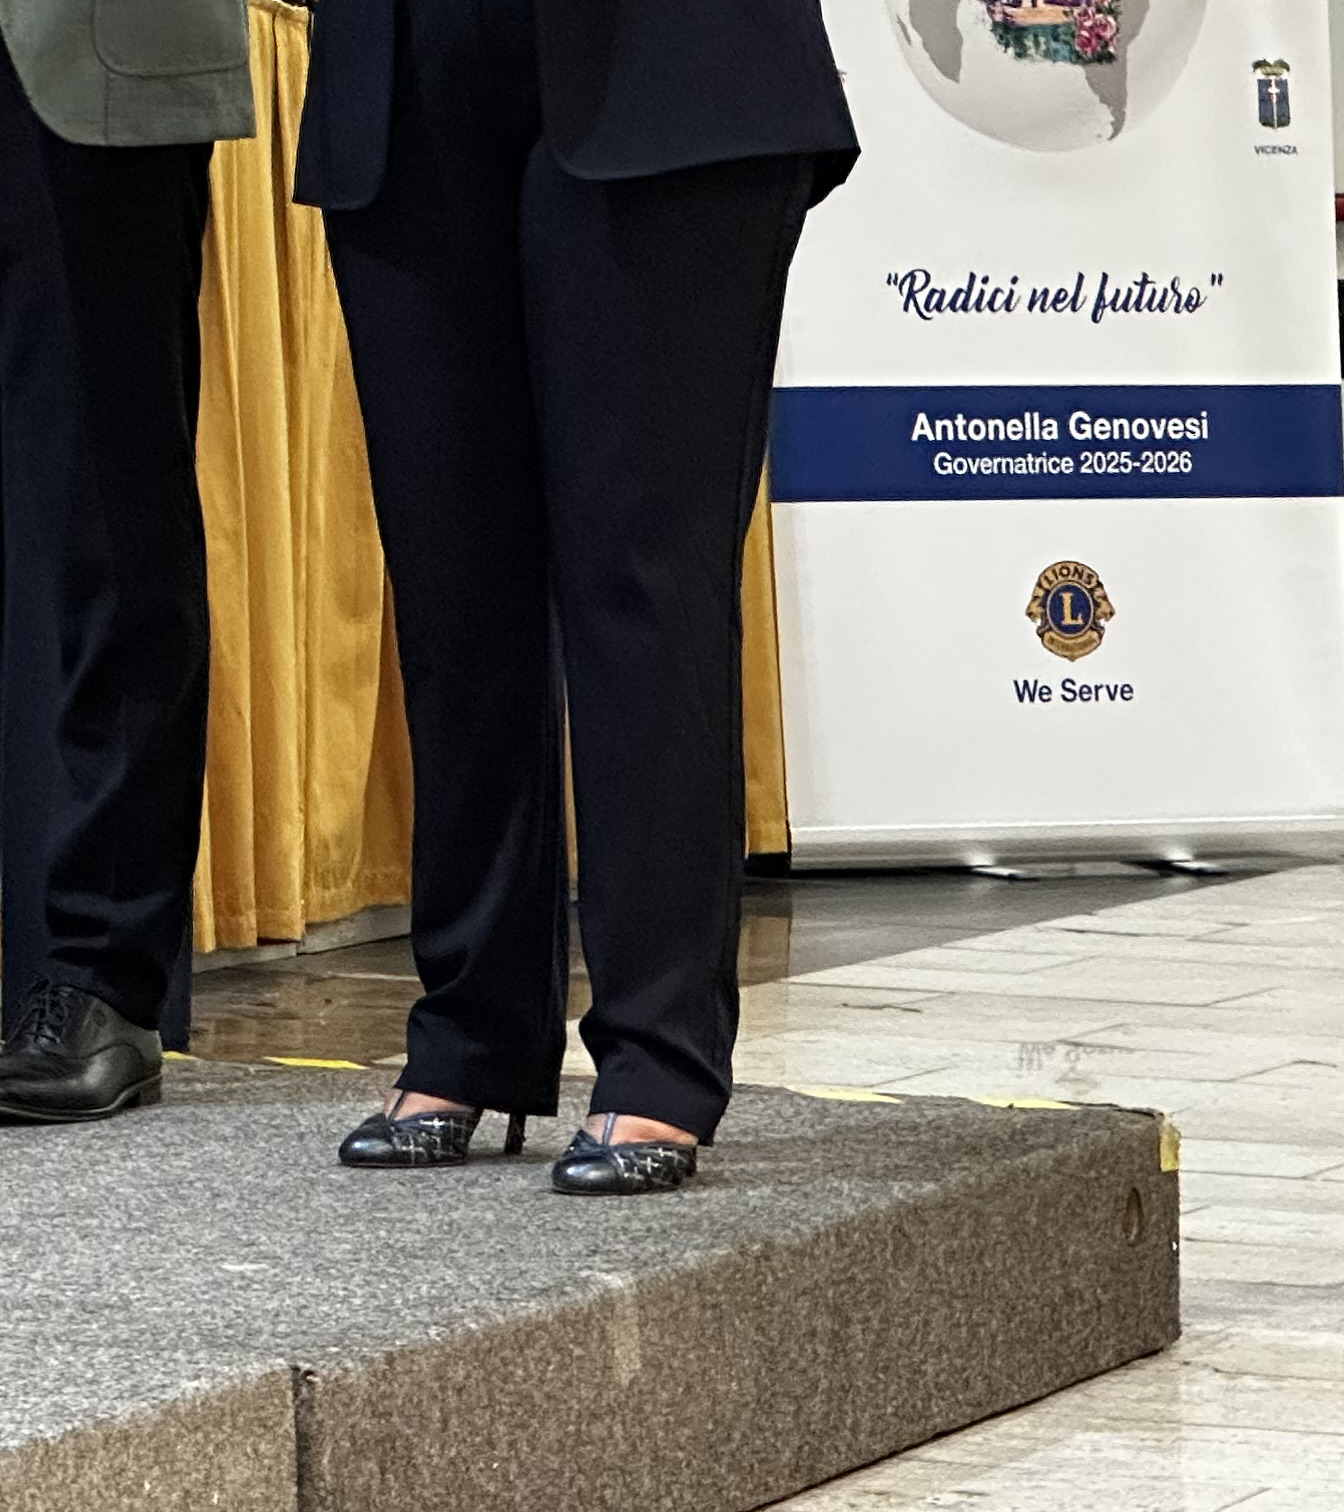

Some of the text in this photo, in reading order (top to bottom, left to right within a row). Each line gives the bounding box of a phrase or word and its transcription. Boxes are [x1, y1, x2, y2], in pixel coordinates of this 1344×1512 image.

[1253, 144, 1299, 156] VICENZA
[1026, 272, 1087, 314] nel
[911, 410, 1209, 442] Antonella Genovesi
[933, 451, 1193, 475] Governatrice 2025-2026
[1043, 565, 1095, 587] LIONS
[1059, 591, 1085, 626] L
[1012, 677, 1134, 704] We Serve
